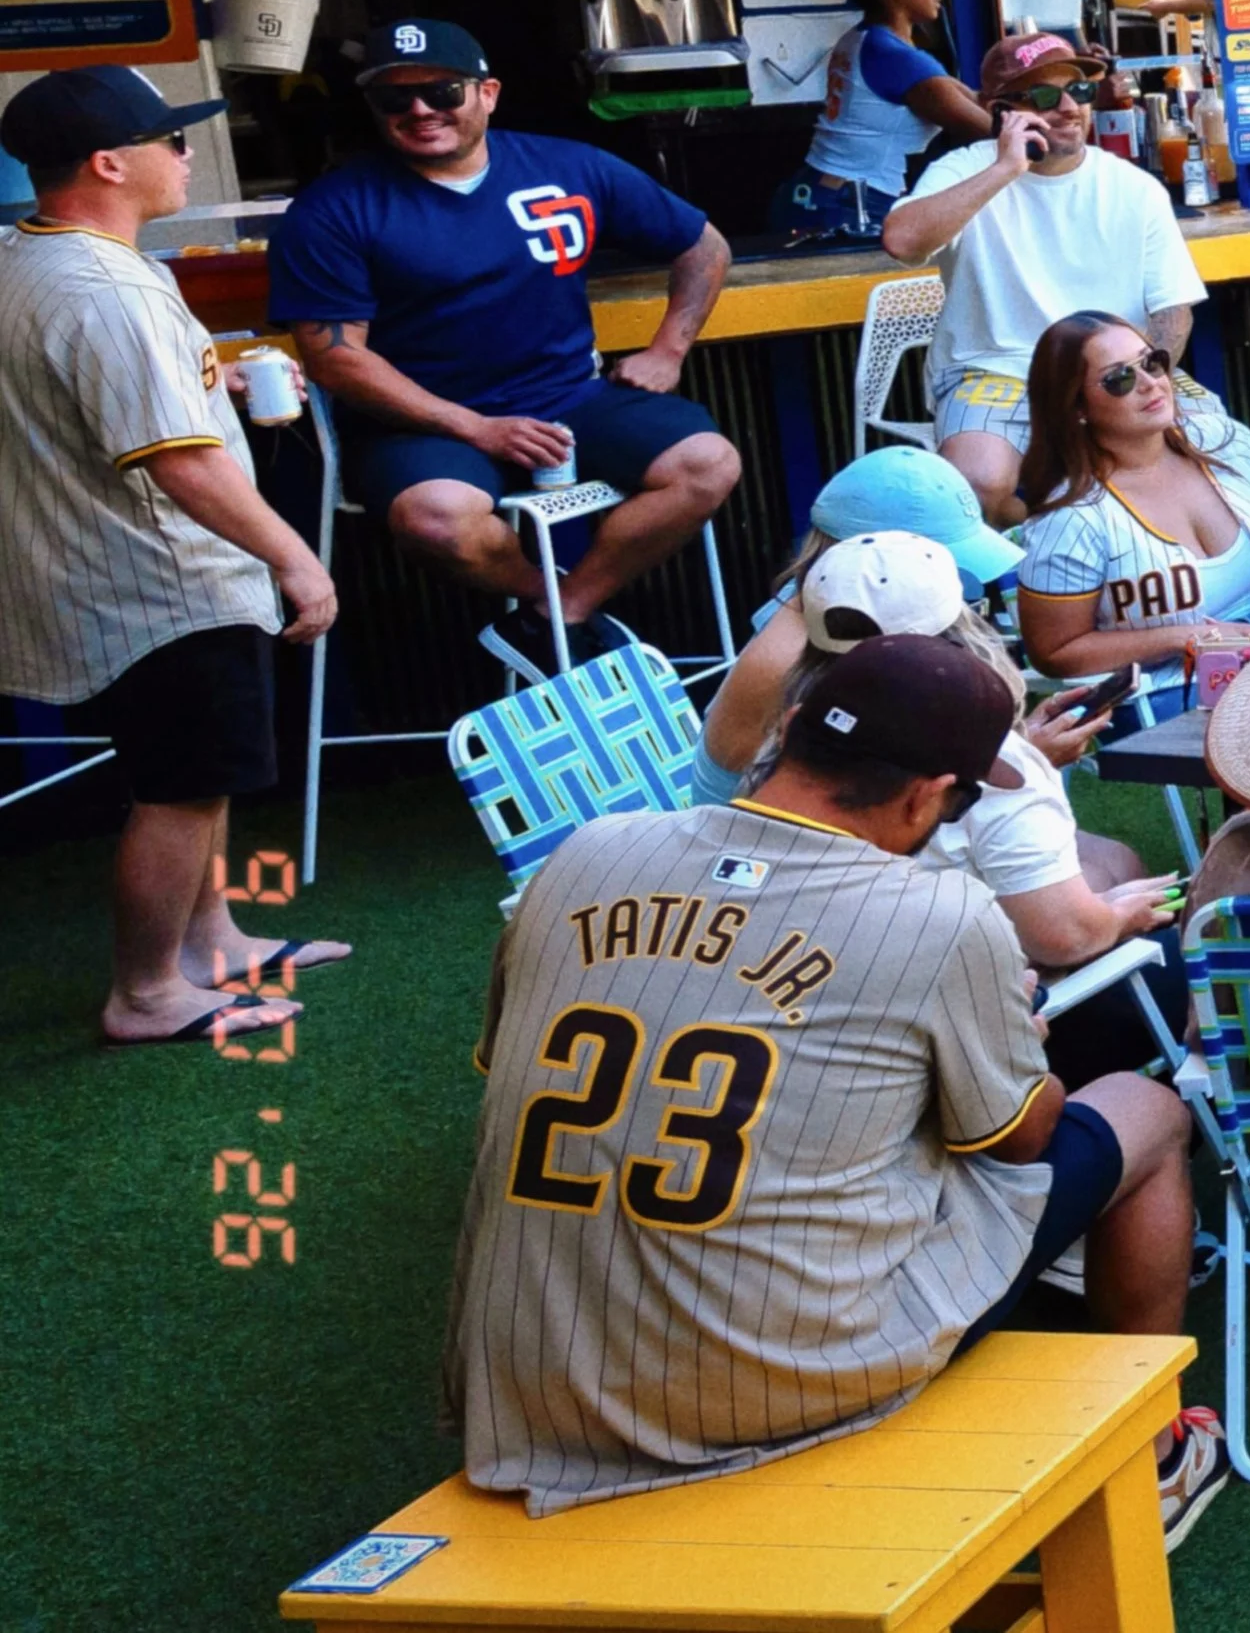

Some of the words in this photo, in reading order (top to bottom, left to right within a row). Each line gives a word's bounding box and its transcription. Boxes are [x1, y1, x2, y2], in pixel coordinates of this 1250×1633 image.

[258, 12, 282, 38] SD
[394, 24, 427, 54] SD
[506, 184, 596, 277] SD
[570, 894, 748, 967] TATIS
[739, 930, 836, 1026] JR.
[505, 1000, 780, 1234] 23
